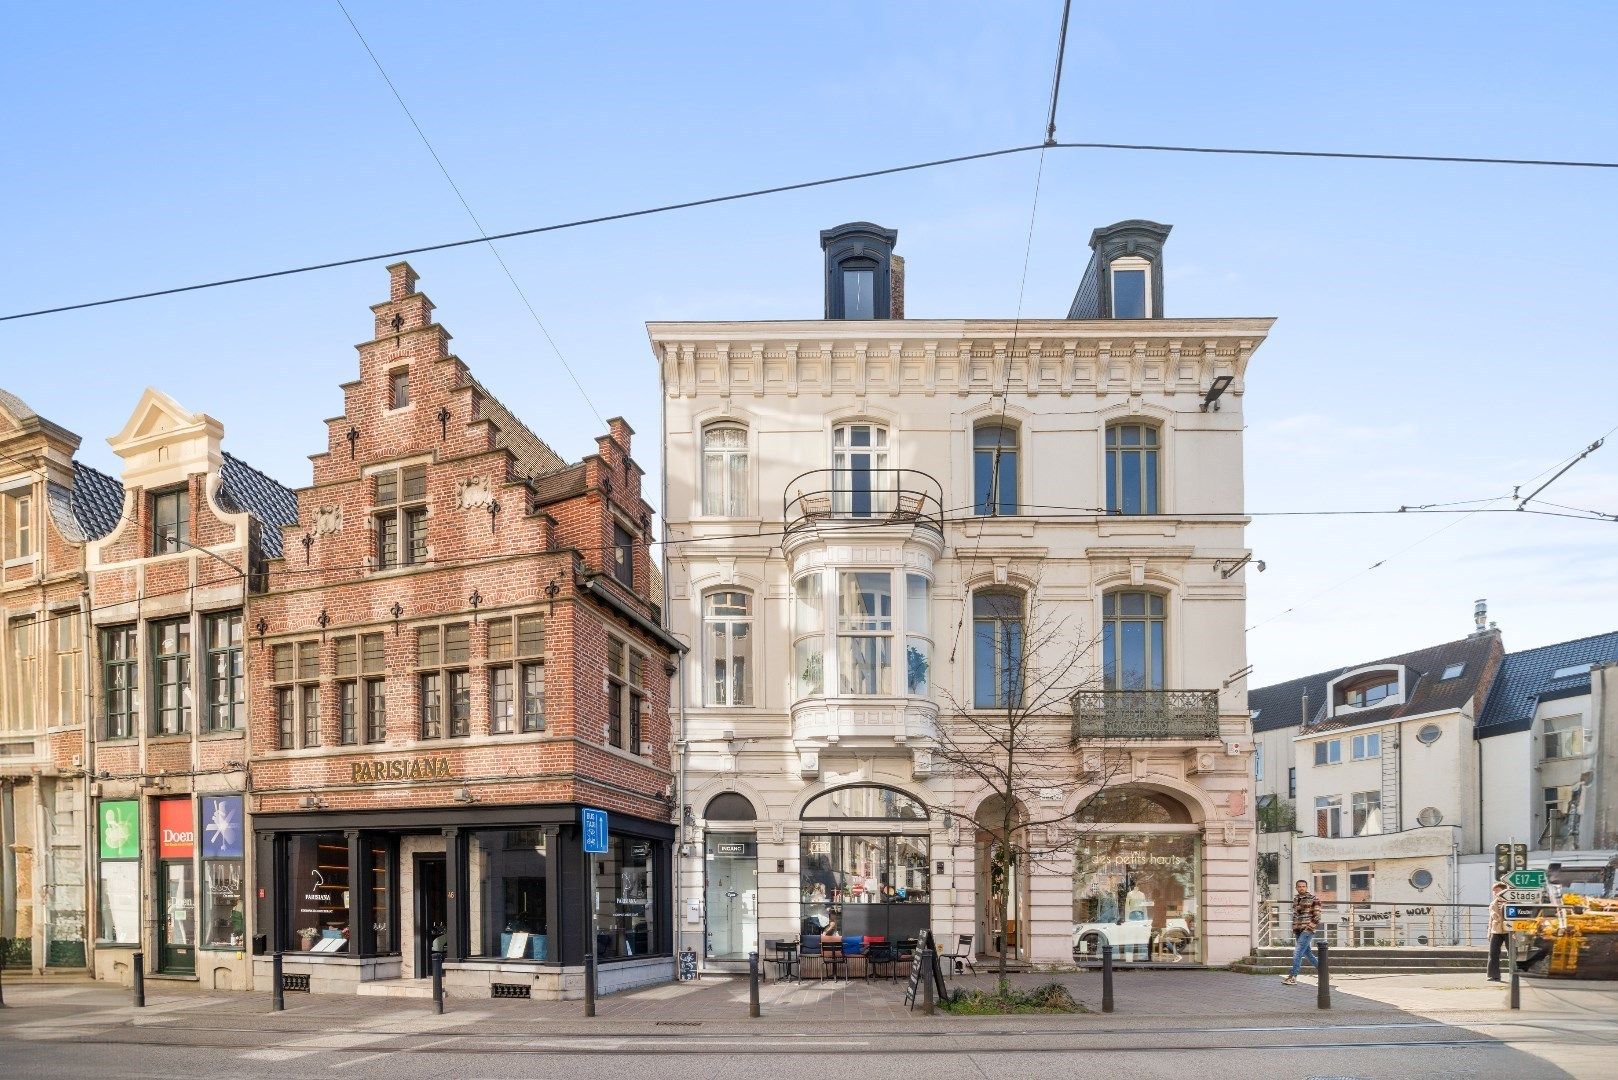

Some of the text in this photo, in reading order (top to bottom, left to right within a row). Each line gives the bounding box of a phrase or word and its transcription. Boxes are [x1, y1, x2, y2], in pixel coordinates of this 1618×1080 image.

[351, 757, 452, 783] PARISIANA
[586, 812, 596, 820] BUS
[1092, 853, 1181, 866] des petits hauts
